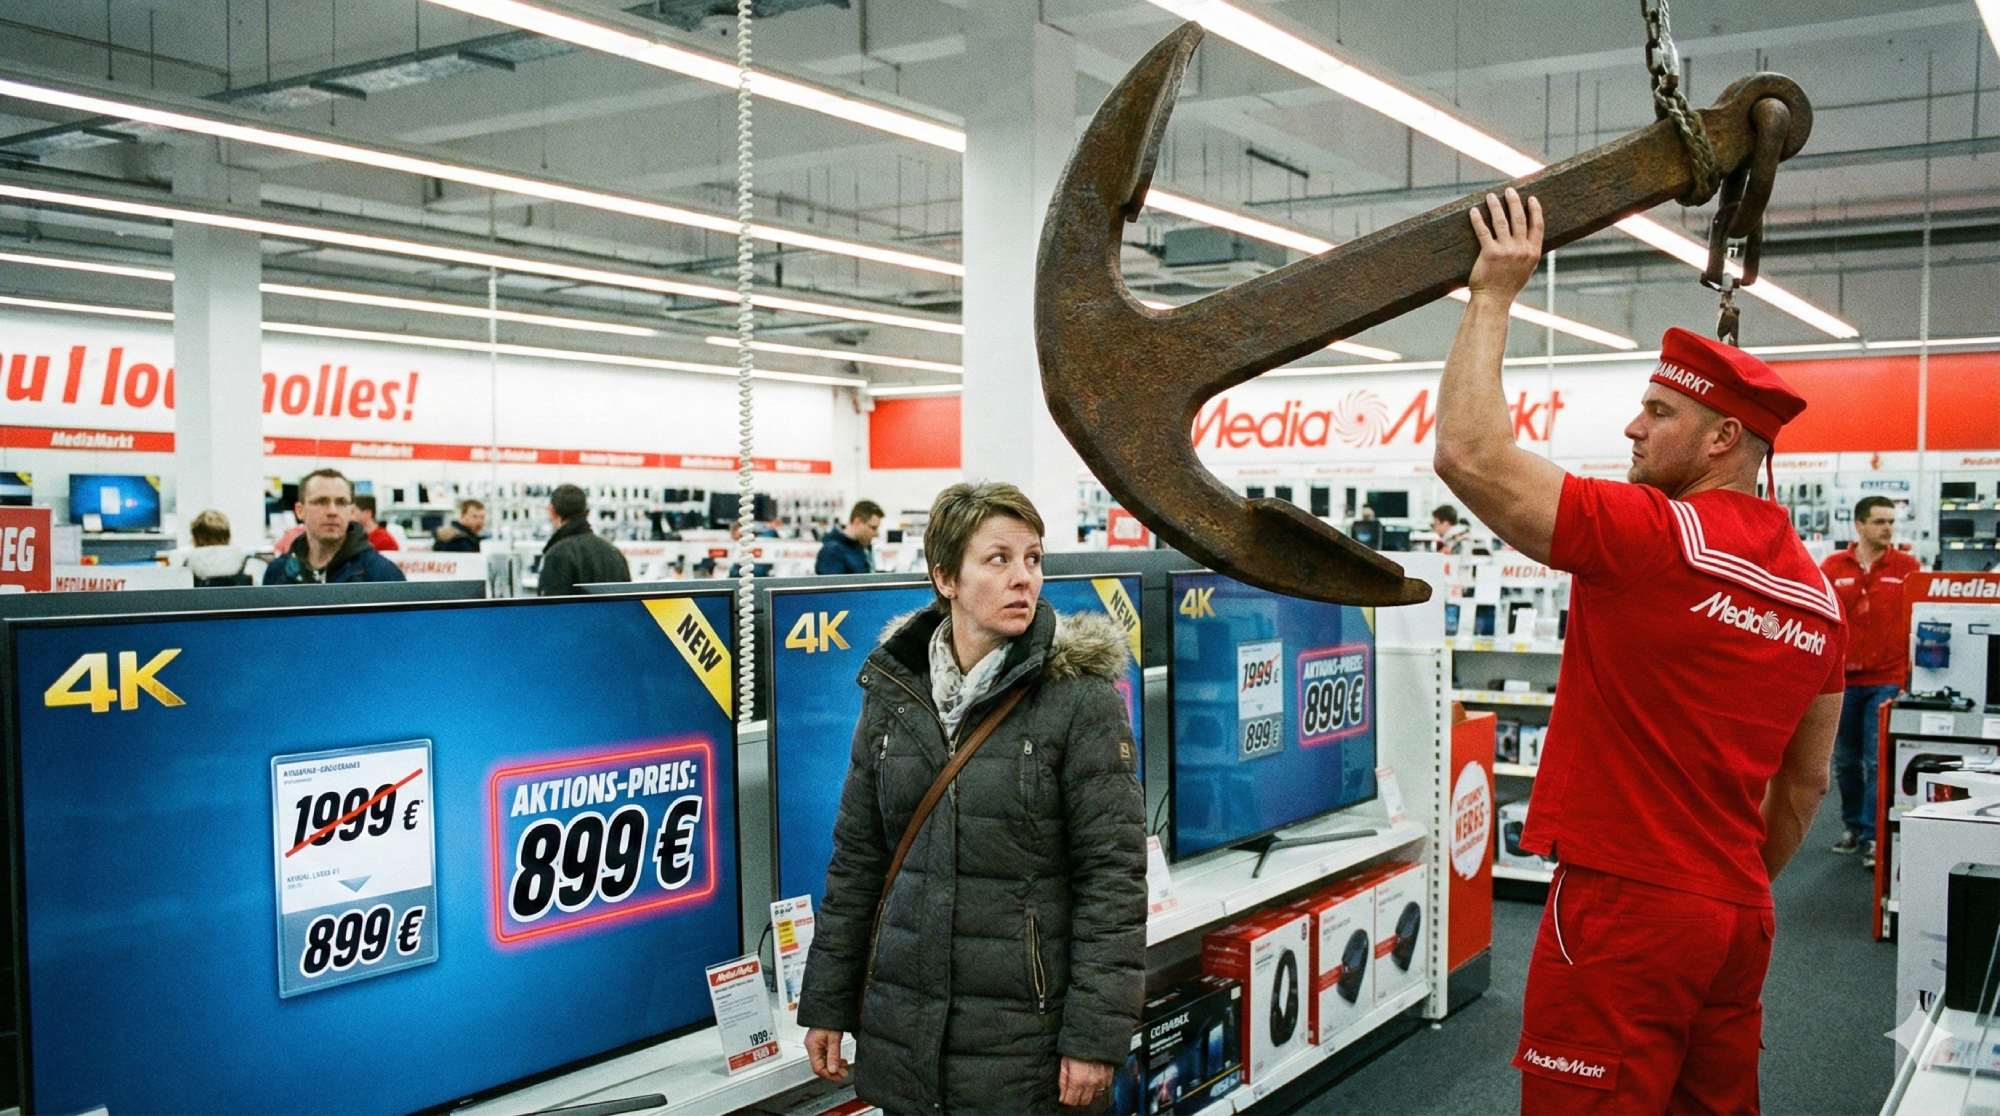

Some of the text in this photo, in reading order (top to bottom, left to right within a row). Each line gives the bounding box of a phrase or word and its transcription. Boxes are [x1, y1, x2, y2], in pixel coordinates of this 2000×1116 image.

[51, 431, 135, 449] MediaMarkt
[1192, 388, 1566, 449] Media Mkt
[0, 526, 37, 573] EG
[1109, 589, 1137, 633] NEW
[1179, 586, 1216, 619] 4K
[1690, 591, 1826, 656] Media Markt
[676, 613, 723, 673] NEW
[785, 610, 851, 653] 4K
[44, 648, 187, 713] 4K
[1243, 659, 1273, 689] 1999
[1304, 674, 1365, 736] 899 €
[1244, 718, 1272, 754] 899
[293, 783, 397, 848] 1999
[510, 760, 697, 817] AKTIONS-PREIS:
[508, 795, 703, 923] 899 €
[300, 903, 427, 978] 899 €
[1523, 1047, 1606, 1078] Media Markt
